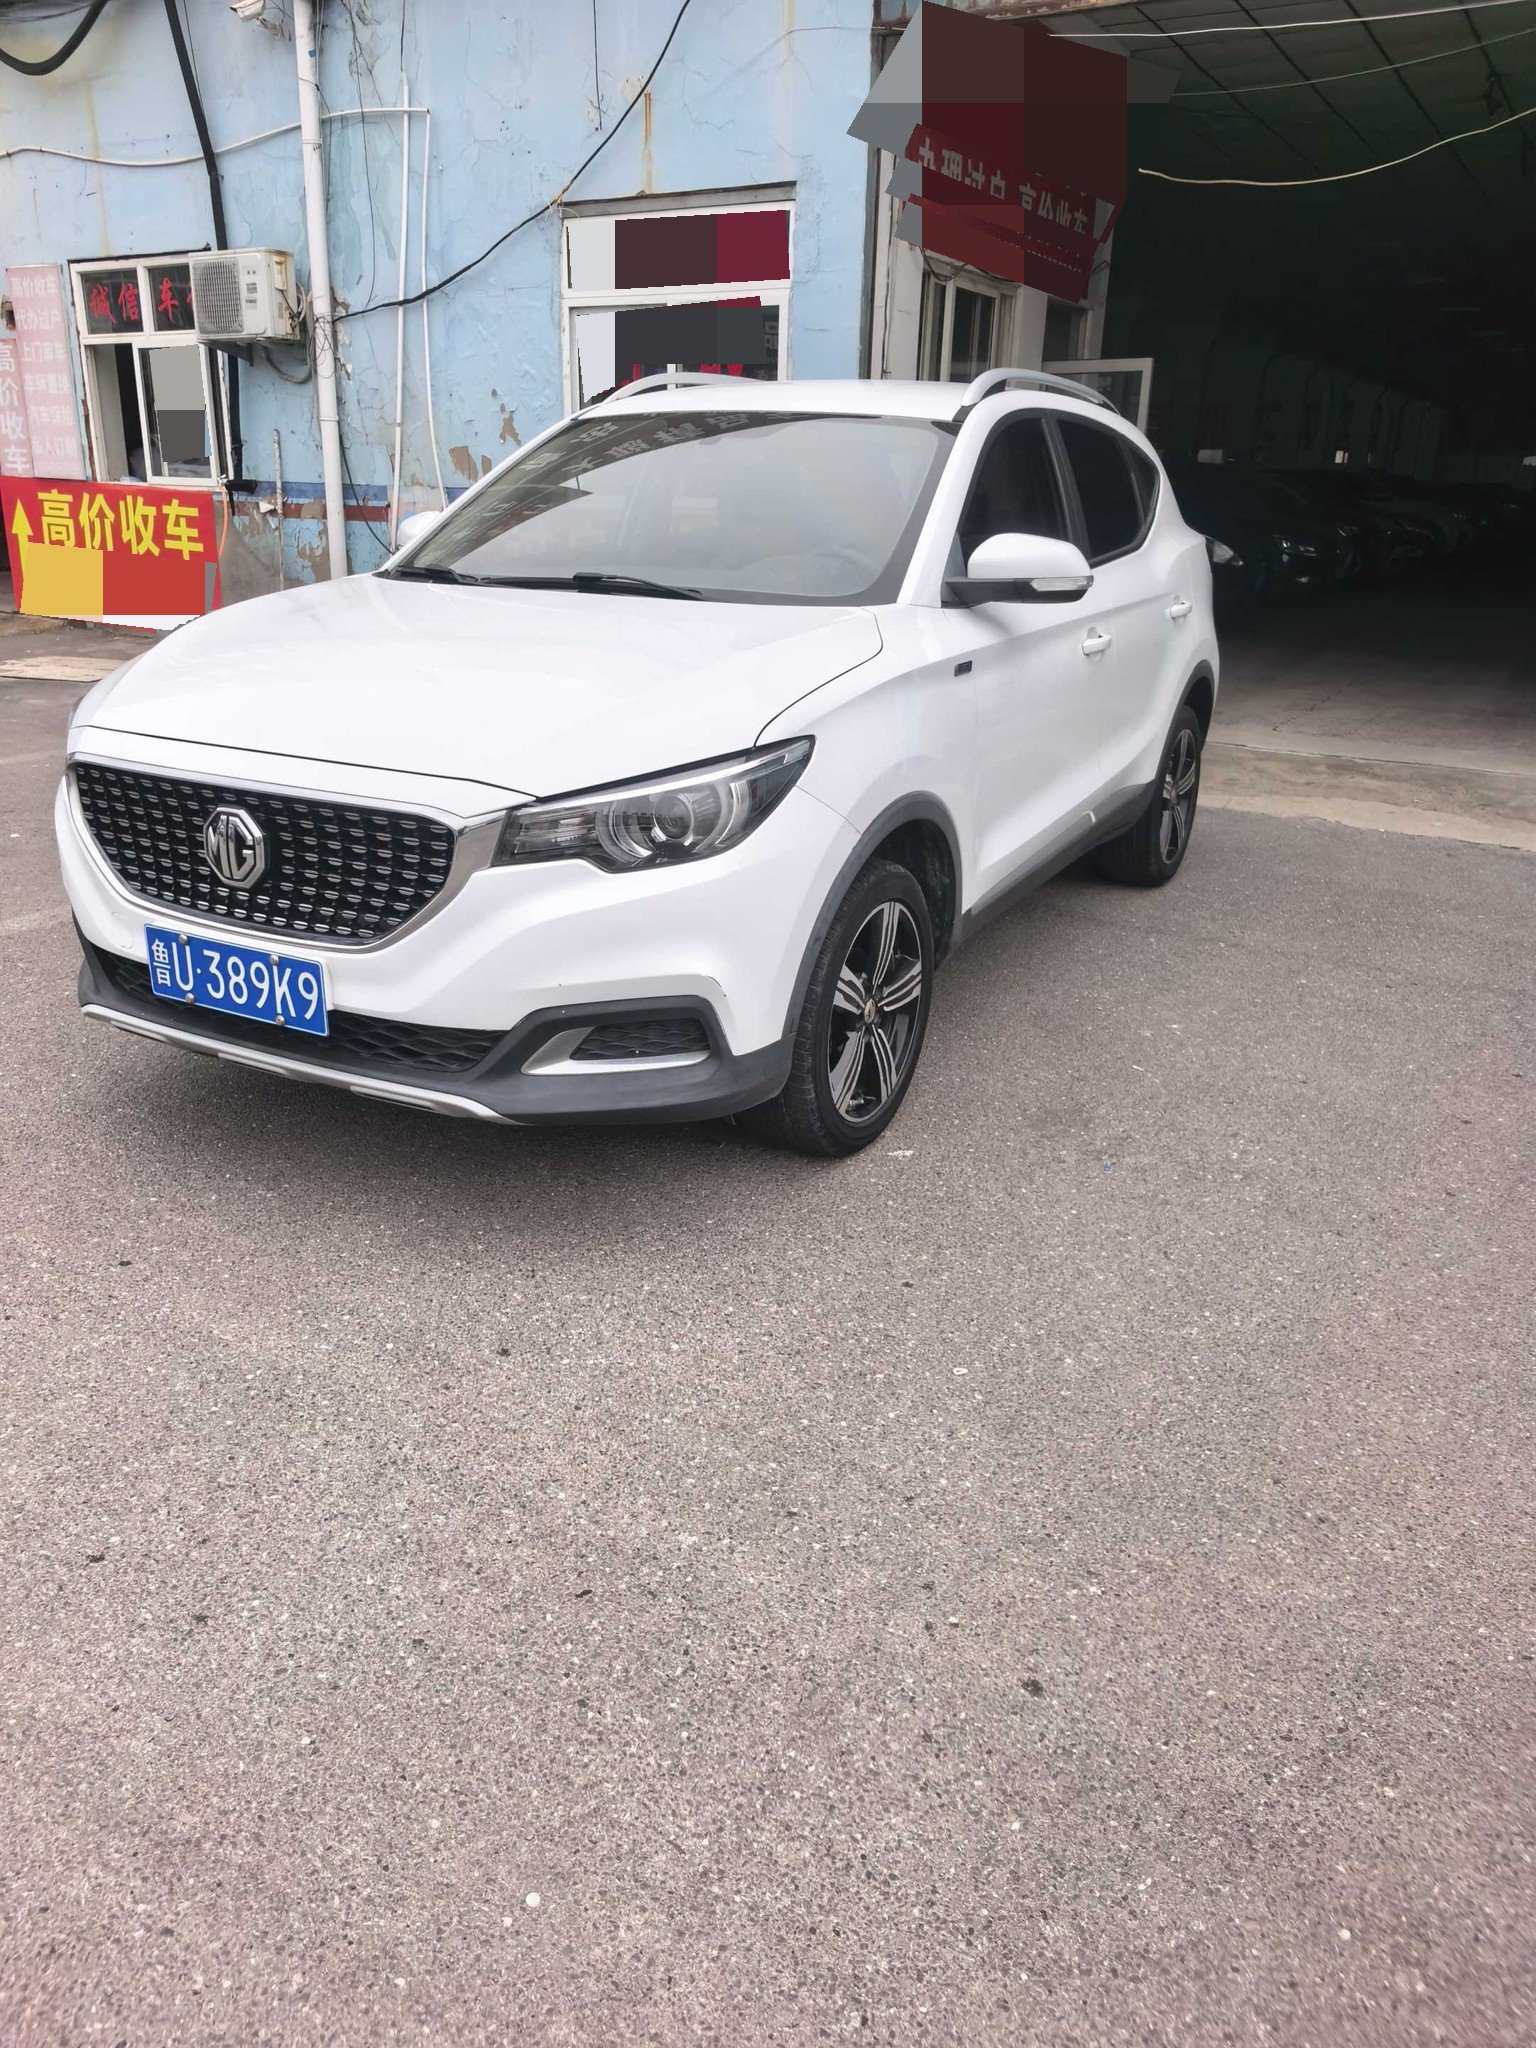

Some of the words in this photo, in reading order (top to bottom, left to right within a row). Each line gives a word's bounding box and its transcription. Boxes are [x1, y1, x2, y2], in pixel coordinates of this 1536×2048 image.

[11, 275, 58, 299] 高价收车
[87, 277, 193, 324] 诚信车
[37, 488, 204, 560] 高价收车
[205, 812, 255, 881] MG
